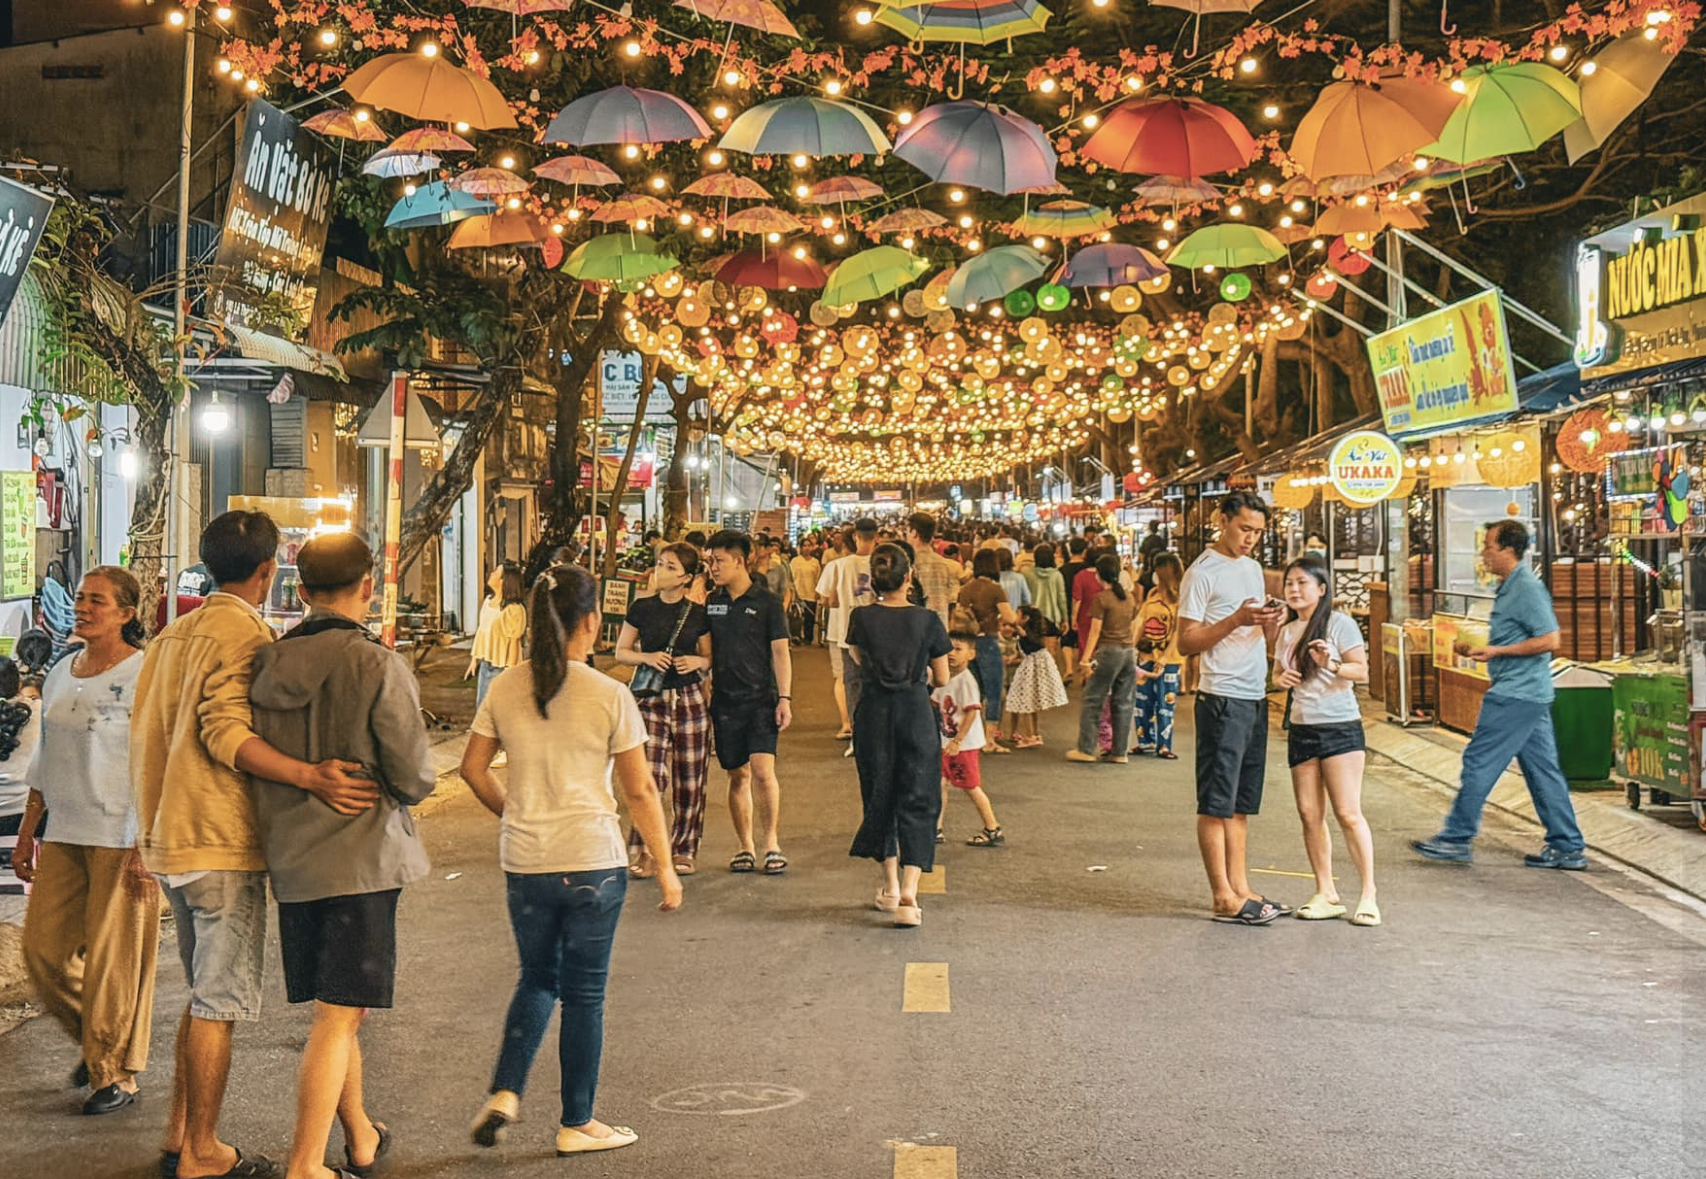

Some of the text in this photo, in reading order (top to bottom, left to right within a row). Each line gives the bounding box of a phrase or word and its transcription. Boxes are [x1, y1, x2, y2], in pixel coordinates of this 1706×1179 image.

[244, 112, 270, 193] Ăn
[268, 138, 298, 216] Vặt
[1608, 228, 1656, 320] NƯỚC
[1656, 213, 1693, 308] MÍA
[1338, 465, 1395, 479] UKAKA
